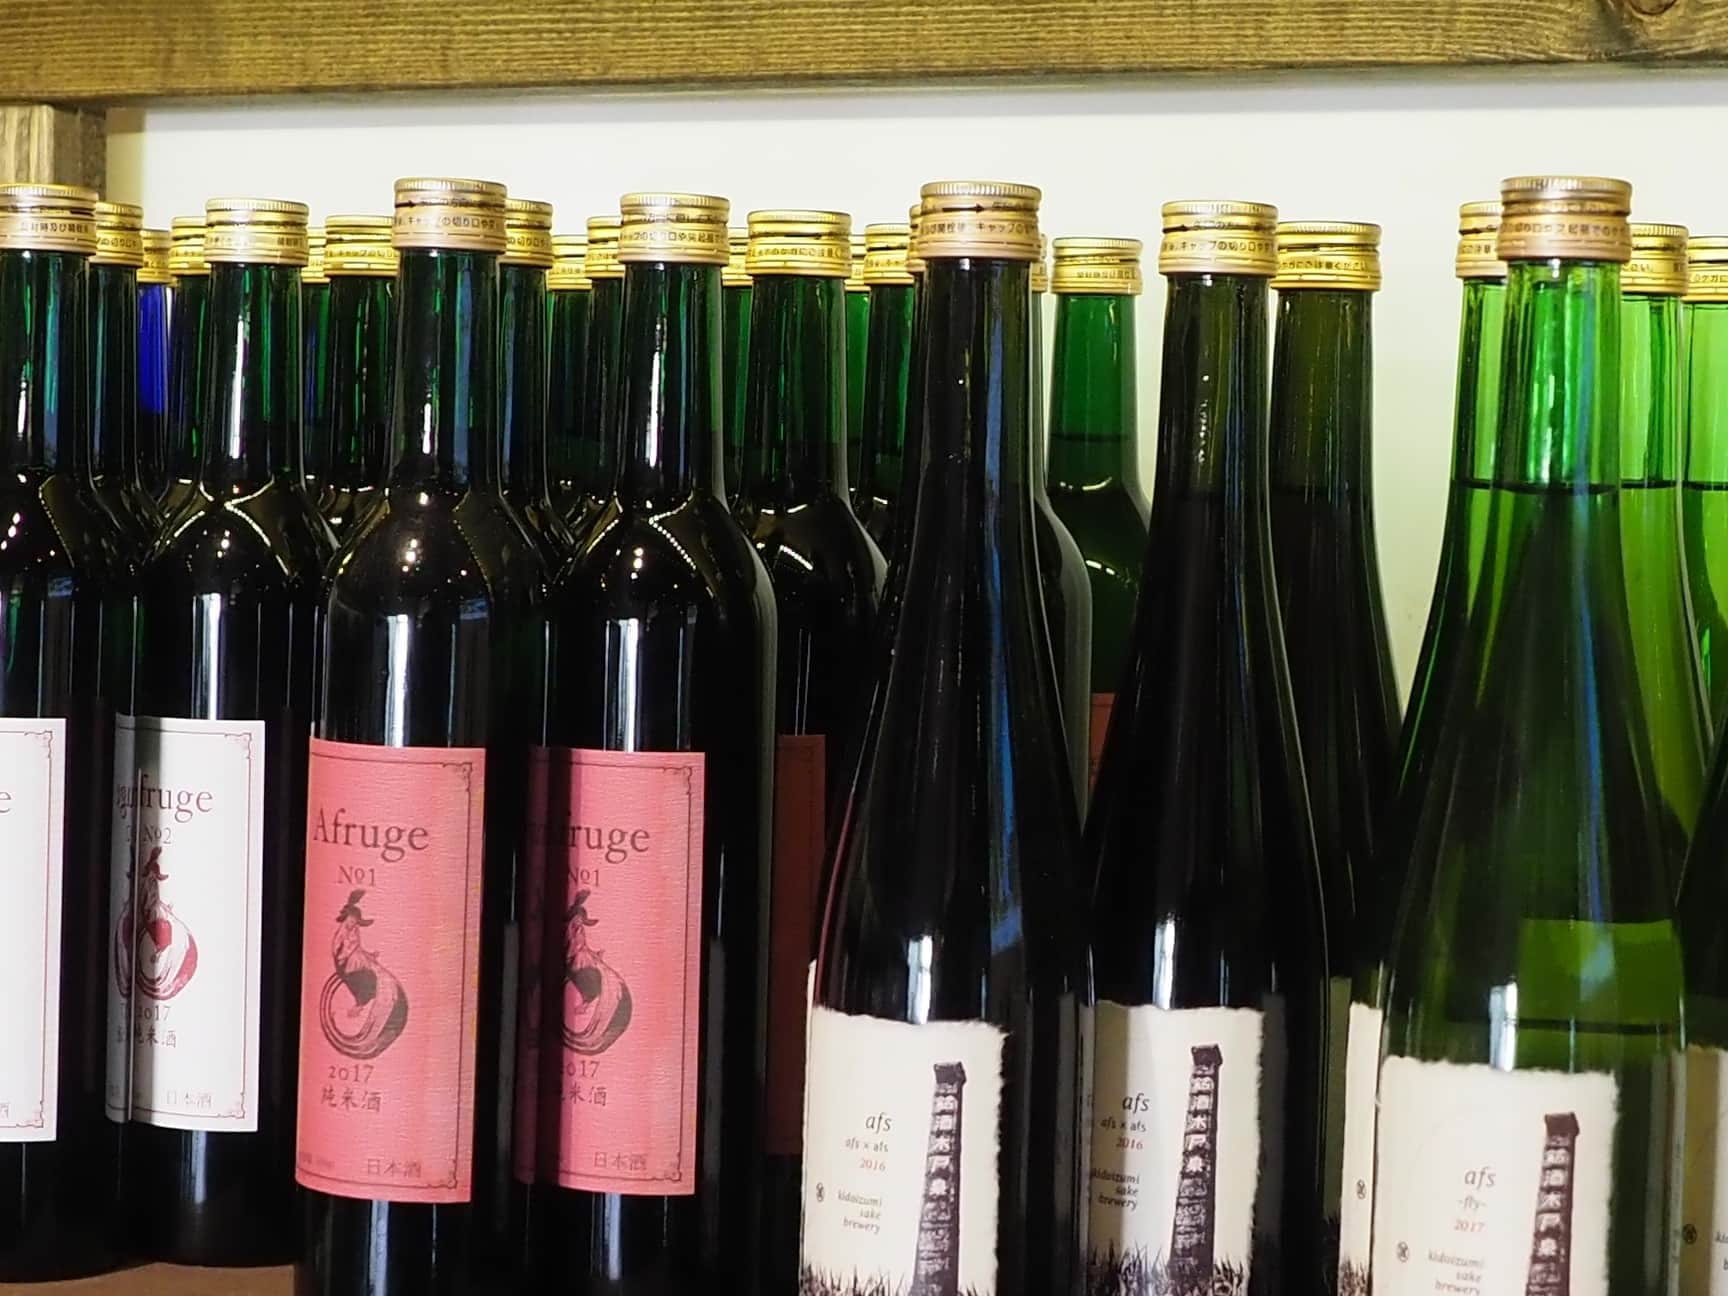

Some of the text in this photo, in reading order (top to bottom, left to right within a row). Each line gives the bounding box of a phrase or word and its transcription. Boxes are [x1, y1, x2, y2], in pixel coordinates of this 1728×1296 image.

[313, 808, 429, 863] Afruge
[327, 1064, 375, 1083] 2017
[320, 1085, 381, 1113] 純米酒
[1122, 1092, 1150, 1114] afs
[865, 1110, 893, 1133] afs
[1114, 1135, 1144, 1151] 2016
[367, 1157, 422, 1179] 日本酒
[593, 1150, 647, 1172] 日本酒
[859, 1157, 886, 1172] 2016
[1464, 1165, 1497, 1191] afs
[1453, 1218, 1485, 1234] 2017
